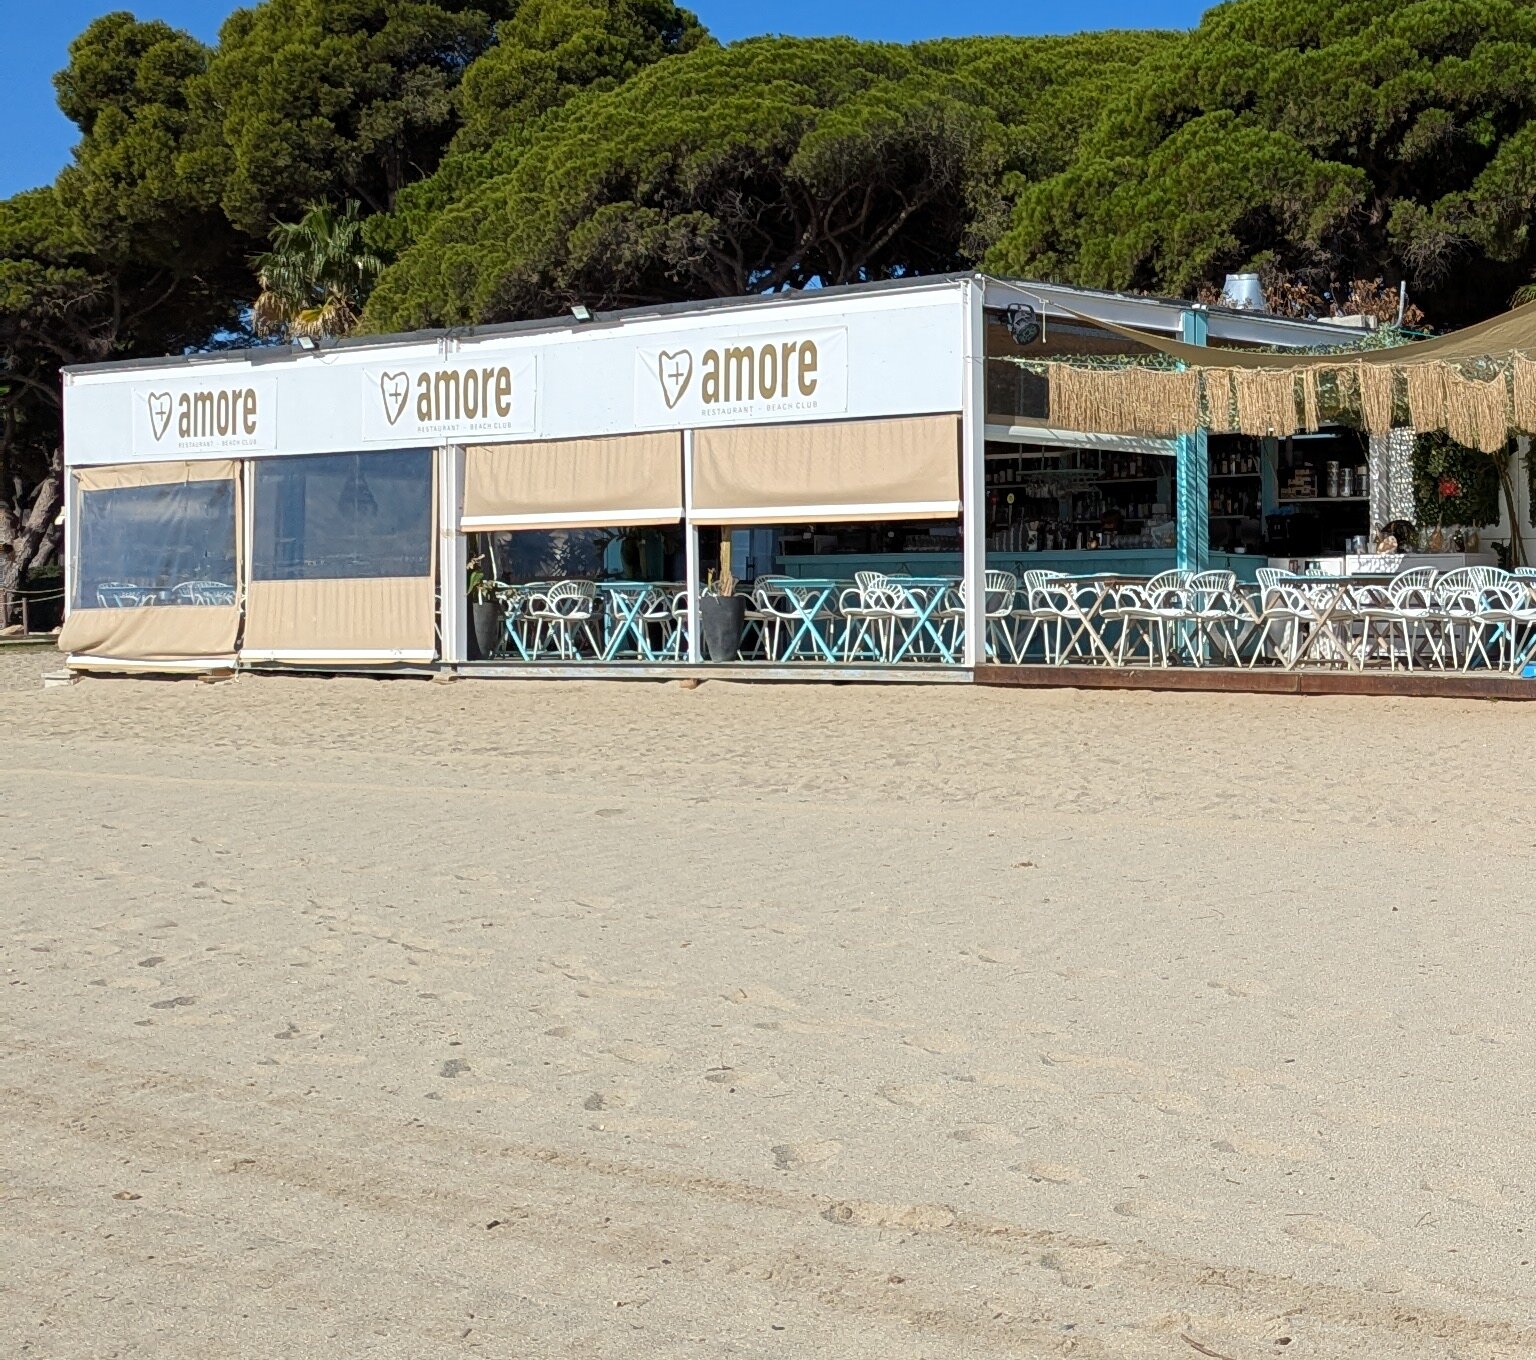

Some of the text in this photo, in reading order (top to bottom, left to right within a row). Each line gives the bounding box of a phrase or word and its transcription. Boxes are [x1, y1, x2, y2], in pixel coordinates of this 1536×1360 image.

[416, 366, 512, 422] amore
[702, 340, 818, 404] amore
[178, 388, 257, 438] amore
[417, 424, 460, 432] RESTAURANT
[701, 406, 754, 415] RESTAURANT
[766, 403, 793, 412] BEACH
[795, 401, 818, 409] CLUB
